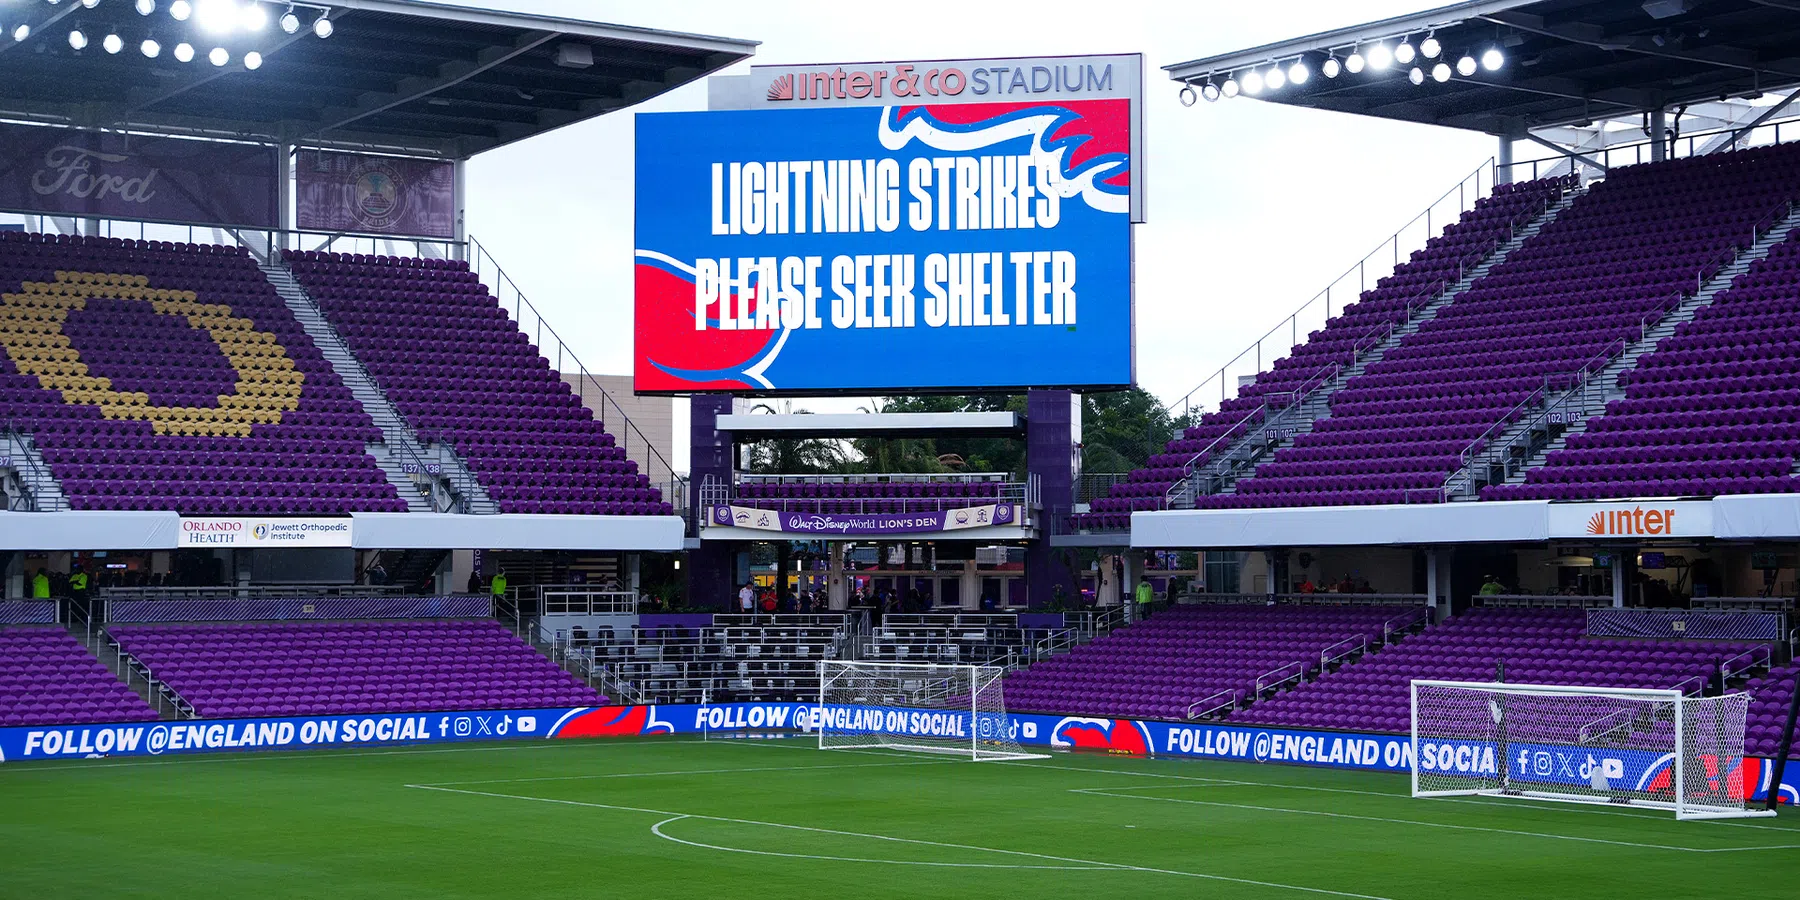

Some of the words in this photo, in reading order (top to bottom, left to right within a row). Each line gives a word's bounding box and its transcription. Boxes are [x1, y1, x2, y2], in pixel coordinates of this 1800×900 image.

[971, 64, 1112, 95] STADIUM
[31, 145, 160, 203] Ford
[711, 158, 899, 235] LIGHTNING
[908, 155, 1060, 231] STRIKES
[695, 256, 822, 330] PLEASE
[831, 254, 915, 329] SEEK
[924, 251, 1076, 328] SHELTER
[1547, 413, 1561, 423] 102
[1567, 412, 1581, 422] 103
[1266, 430, 1277, 438] 101
[403, 464, 418, 473] 137
[425, 464, 440, 473] 138
[849, 519, 875, 529] World
[879, 519, 912, 528] LION'S
[916, 518, 937, 527] DEN
[1608, 505, 1675, 534] inter
[183, 521, 242, 531] ORLANDO
[300, 523, 347, 532] Orthopedic
[189, 532, 235, 543] HEALTH
[271, 532, 305, 540] Institute
[695, 706, 789, 729] FOLLOW
[793, 705, 884, 731] @ENGLAND
[887, 712, 910, 732] ON
[911, 713, 965, 736] SOCIAL
[24, 728, 143, 755] FOLLOW
[146, 723, 293, 755] @ENGLAND
[300, 720, 339, 743] ON
[341, 717, 430, 741] SOCIAL
[1167, 728, 1251, 757] FOLLOW
[1253, 732, 1379, 765] @ENGLAND
[1384, 741, 1412, 768] ON
[1421, 743, 1498, 773] SOCIA
